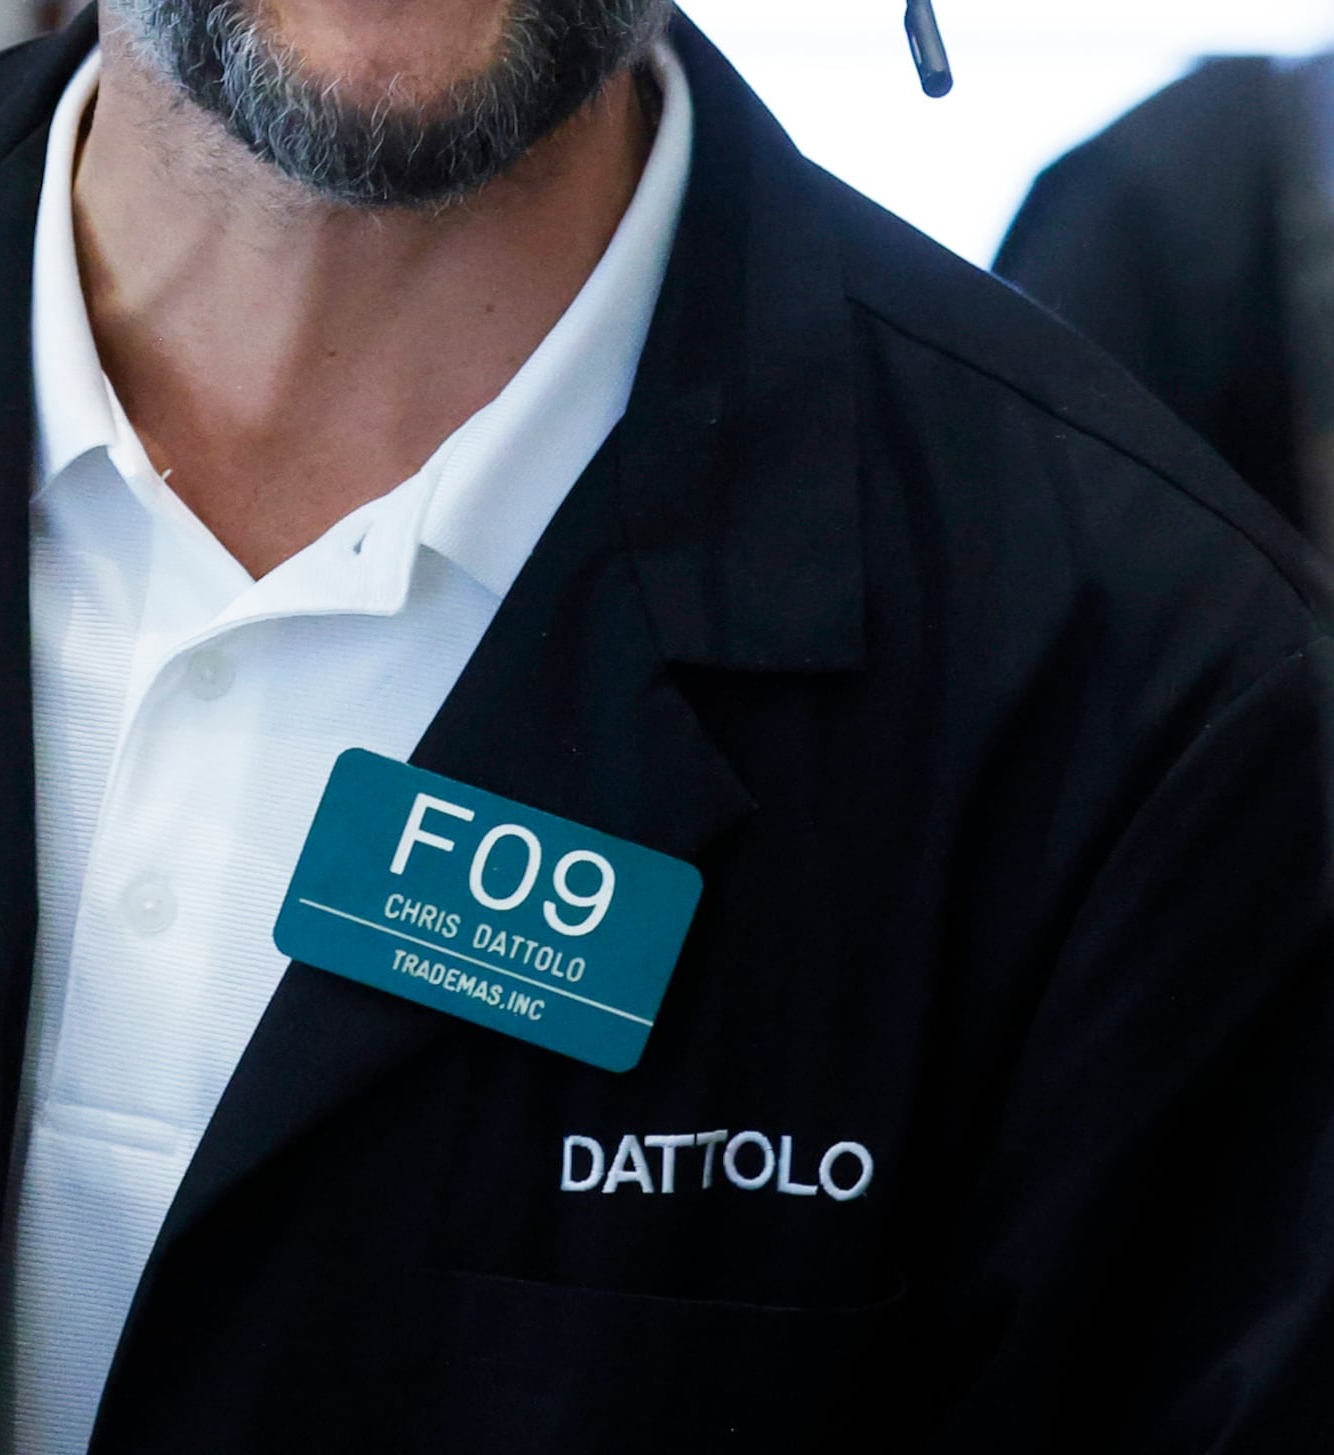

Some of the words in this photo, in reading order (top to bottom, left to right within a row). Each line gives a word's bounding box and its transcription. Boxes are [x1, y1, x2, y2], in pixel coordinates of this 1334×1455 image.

[389, 792, 617, 937] F09
[383, 893, 462, 939] CHRIS
[472, 924, 587, 983] DATTOLO
[560, 1129, 875, 1202] DATTOLO
